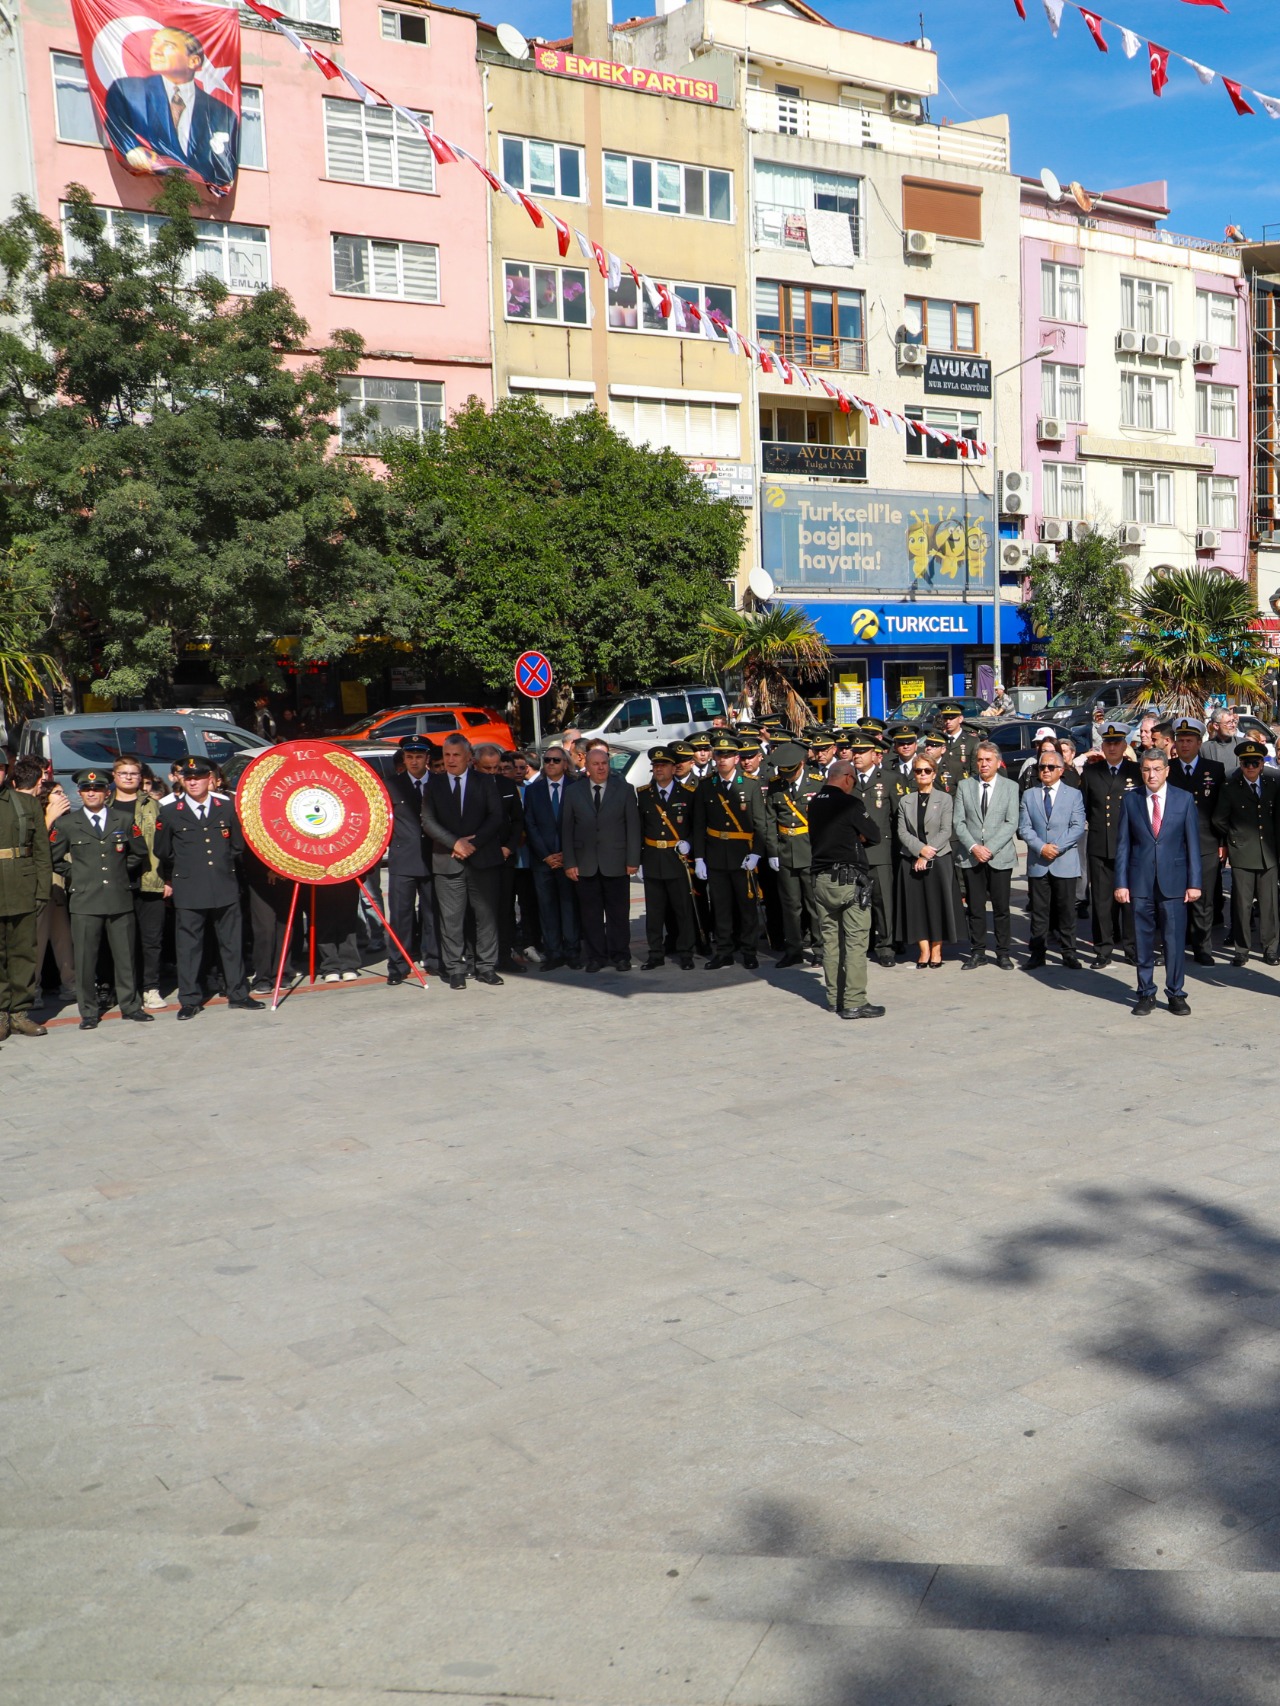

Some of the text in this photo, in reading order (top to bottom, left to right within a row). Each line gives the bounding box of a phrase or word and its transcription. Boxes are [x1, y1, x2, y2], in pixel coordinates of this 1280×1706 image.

[565, 55, 714, 100] EMEK PARTİSİ
[231, 278, 269, 290] EMLAK
[928, 358, 989, 379] AVUKAT
[928, 380, 989, 393] NUR EVLA CANTÜRK
[796, 446, 864, 462] AVUKAT
[805, 460, 854, 470] Tulga UYAR
[798, 500, 902, 524] Turkcell'le
[798, 523, 873, 550] bağlan
[798, 548, 881, 574] hayata!
[884, 616, 968, 633] TURKCELL
[270, 769, 354, 801] BURHANİYE
[270, 811, 363, 856] KAYMAKAMLIĞI
